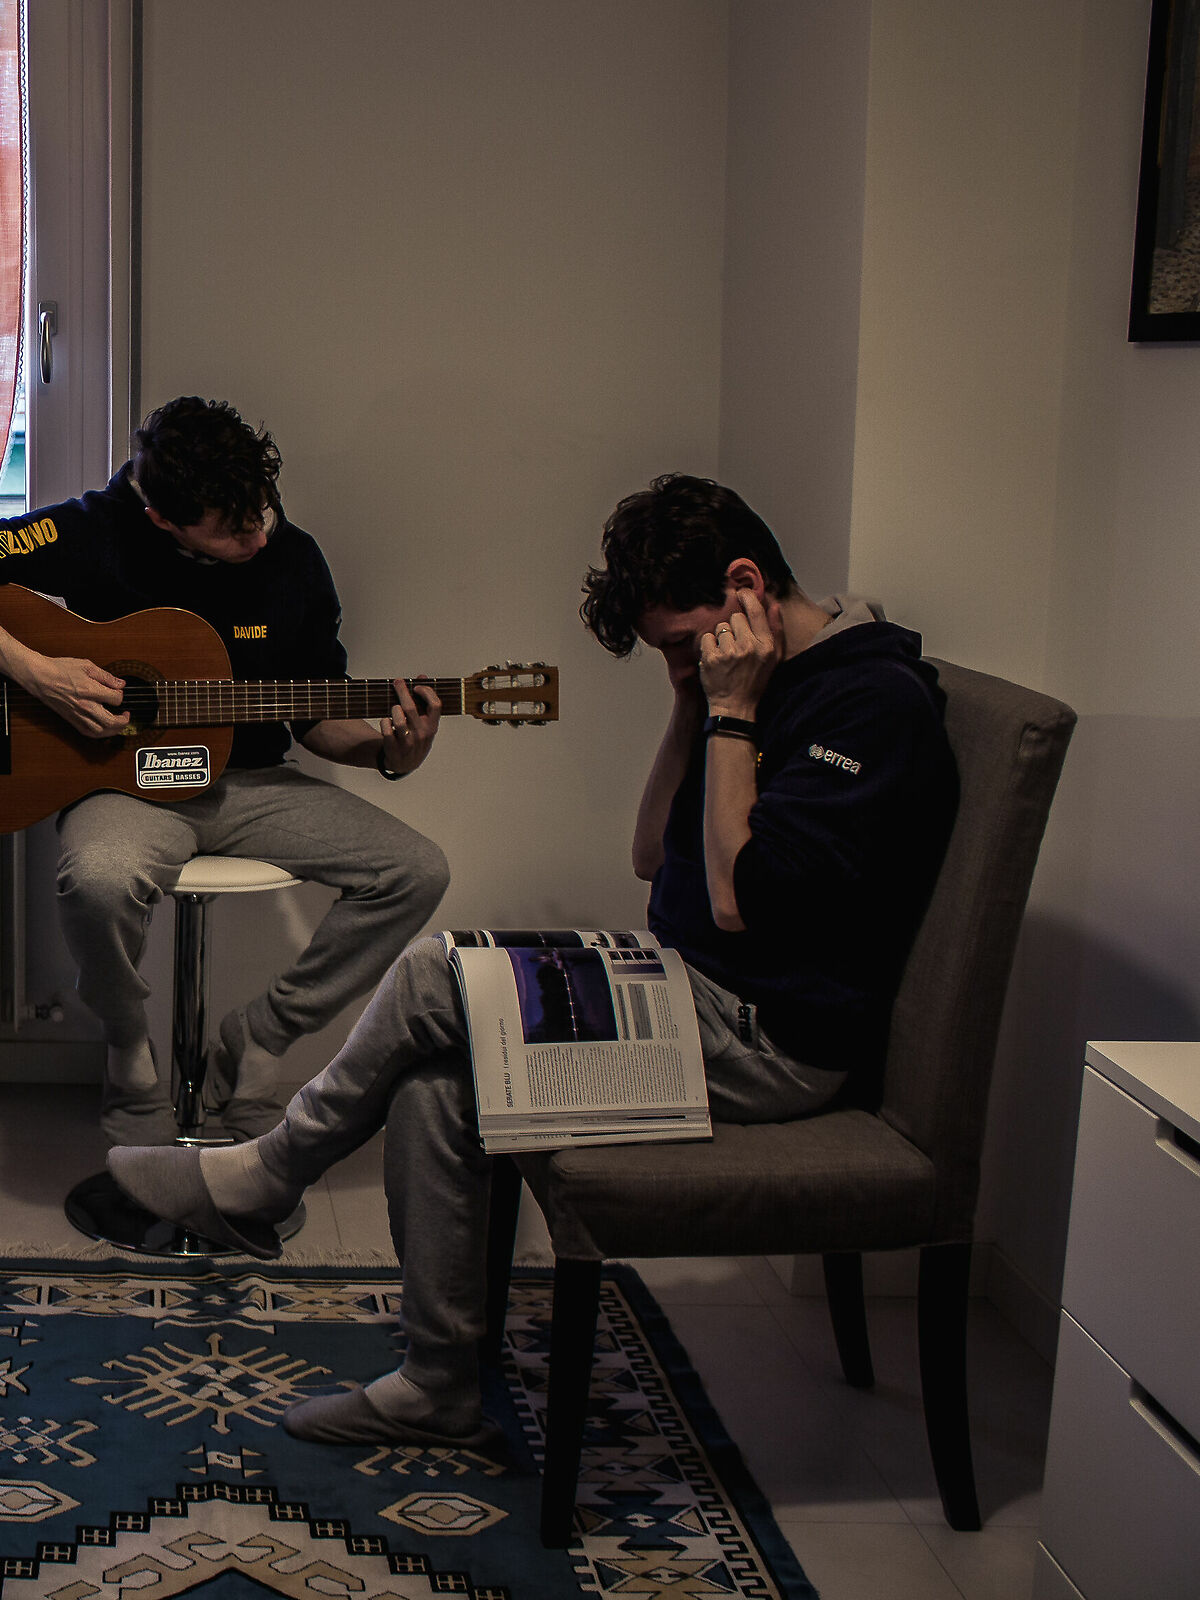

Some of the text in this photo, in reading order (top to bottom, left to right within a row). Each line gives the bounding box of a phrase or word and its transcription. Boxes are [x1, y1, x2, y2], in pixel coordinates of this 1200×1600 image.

[233, 625, 268, 639] DAVIDE
[142, 752, 204, 769] Ibanez
[175, 773, 201, 781] BASSES
[505, 1086, 514, 1108] SERATE
